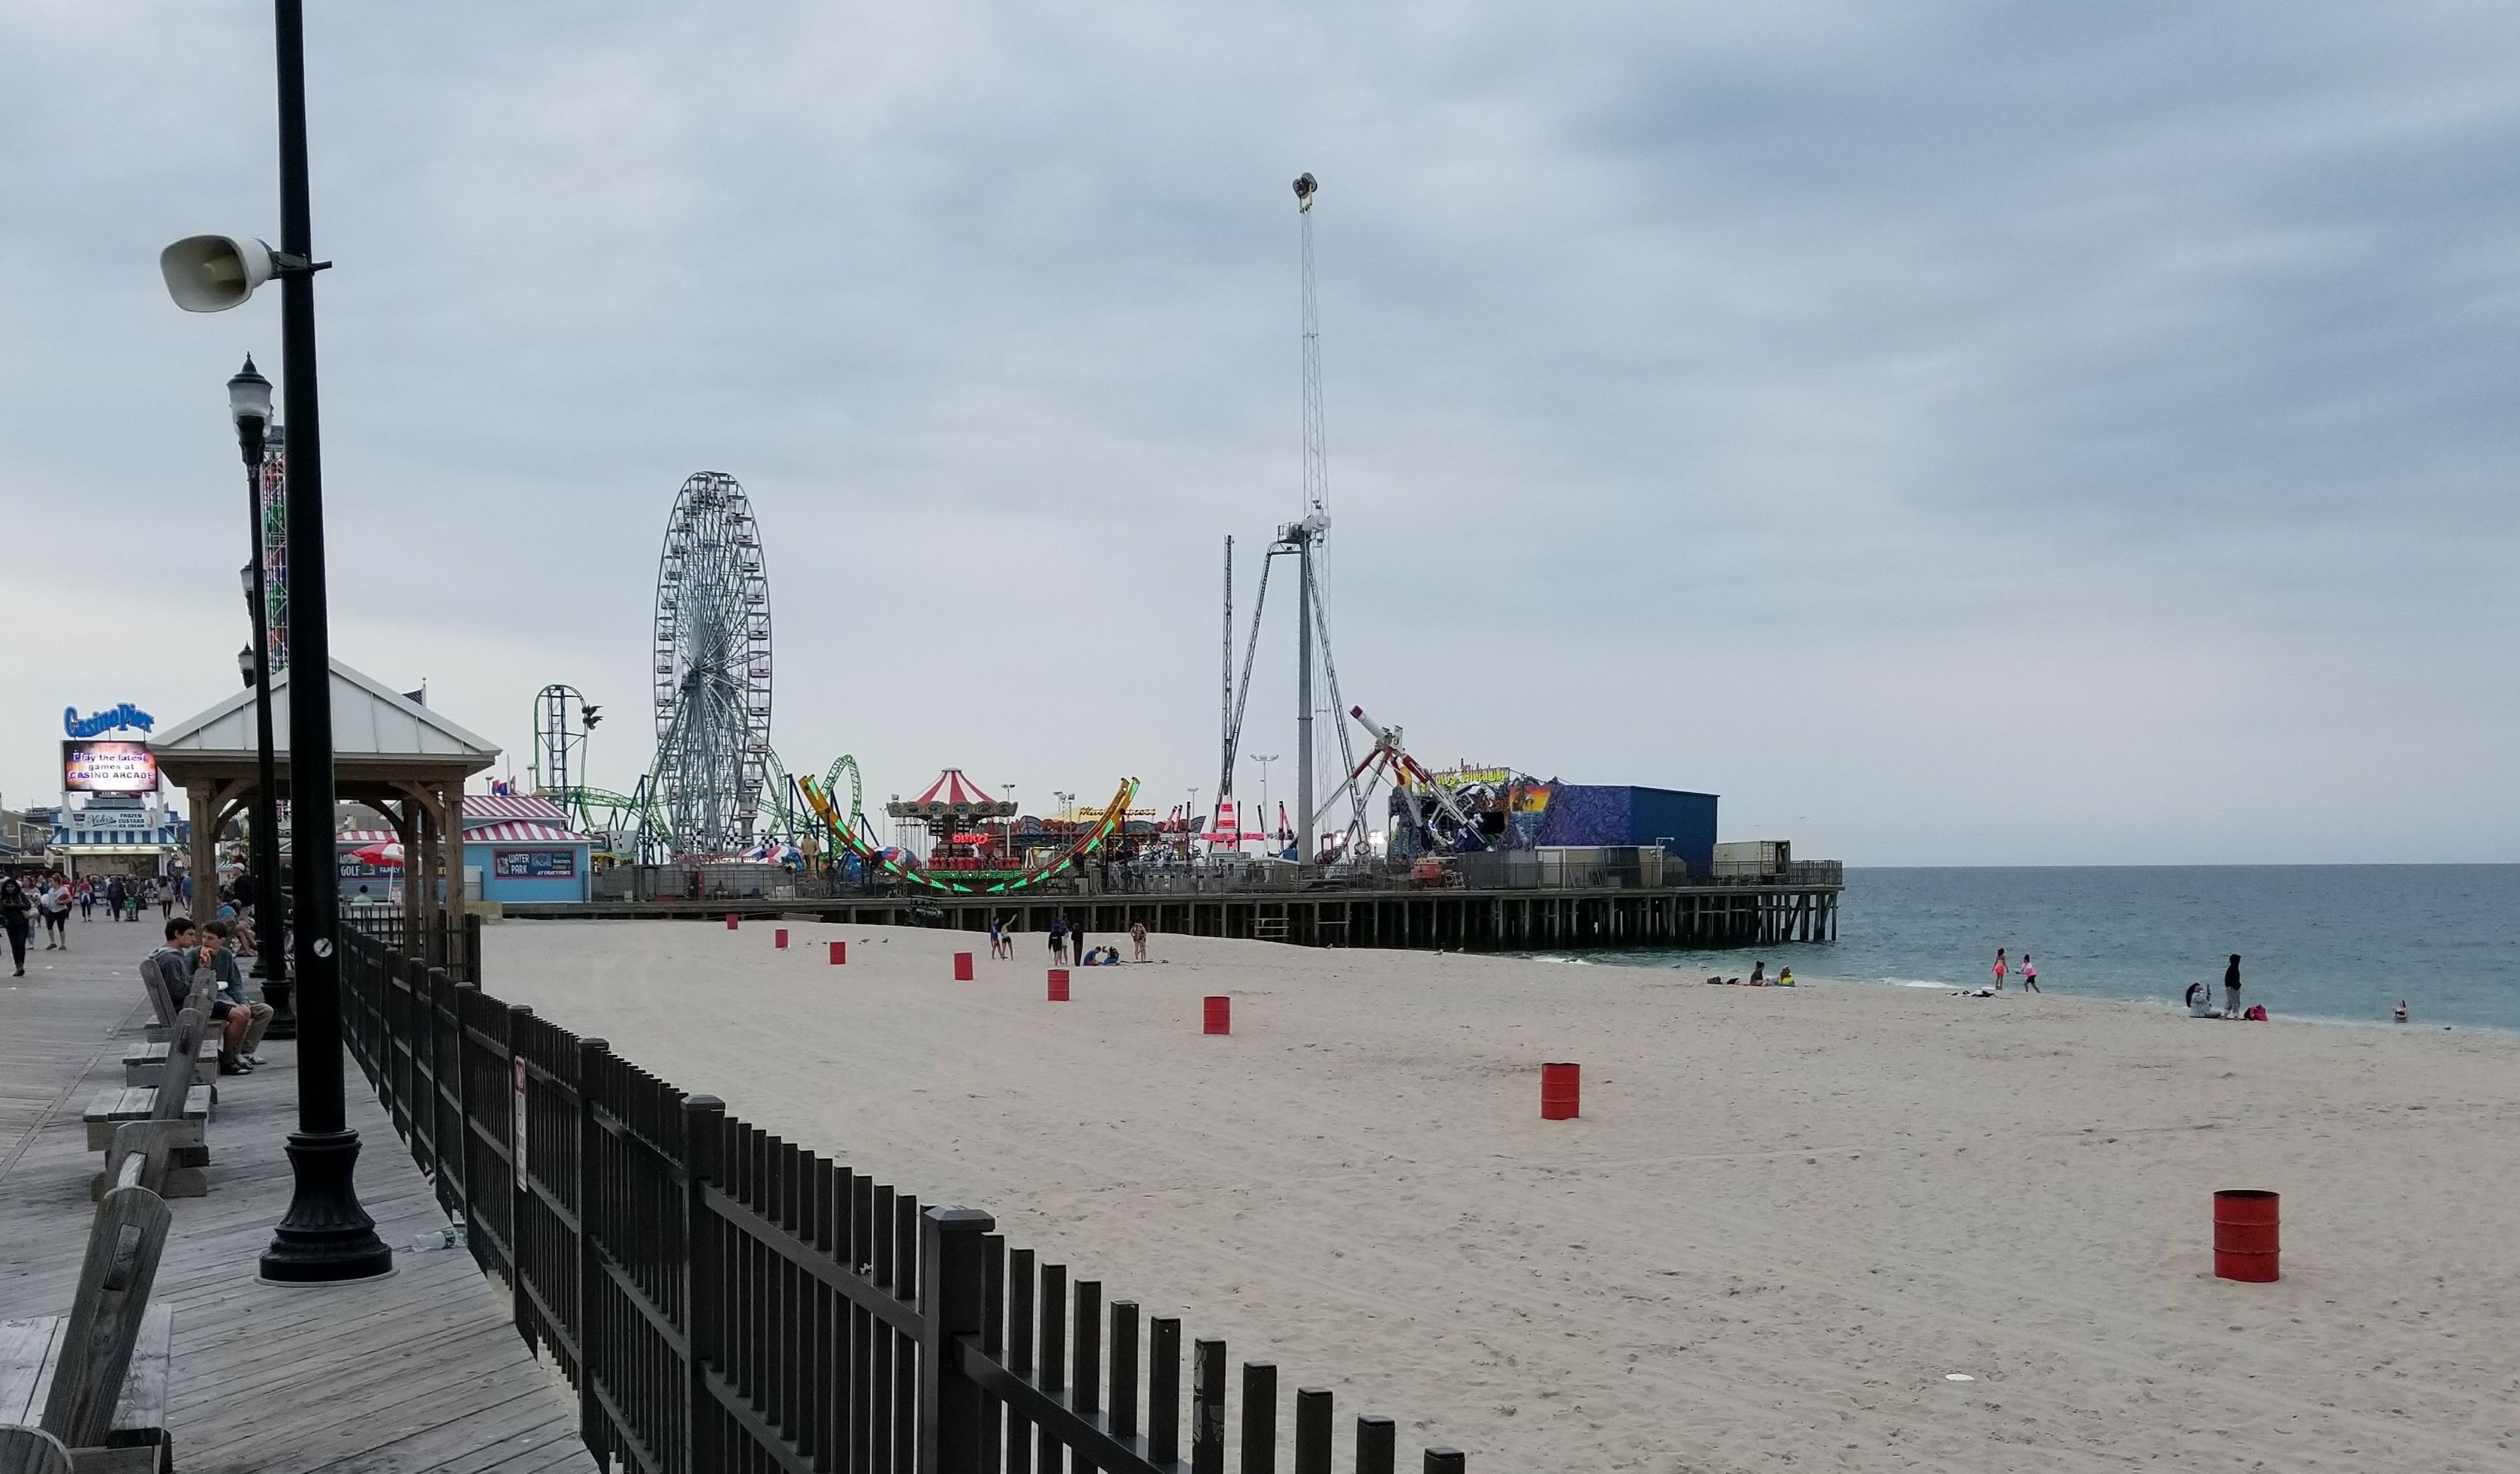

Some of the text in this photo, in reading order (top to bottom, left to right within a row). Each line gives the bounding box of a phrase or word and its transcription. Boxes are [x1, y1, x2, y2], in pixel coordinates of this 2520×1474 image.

[64, 702, 155, 738] Casino Pier
[118, 752, 147, 761] latest
[509, 854, 530, 864] WATER
[340, 865, 361, 876] GOLF
[511, 865, 528, 875] PARK
